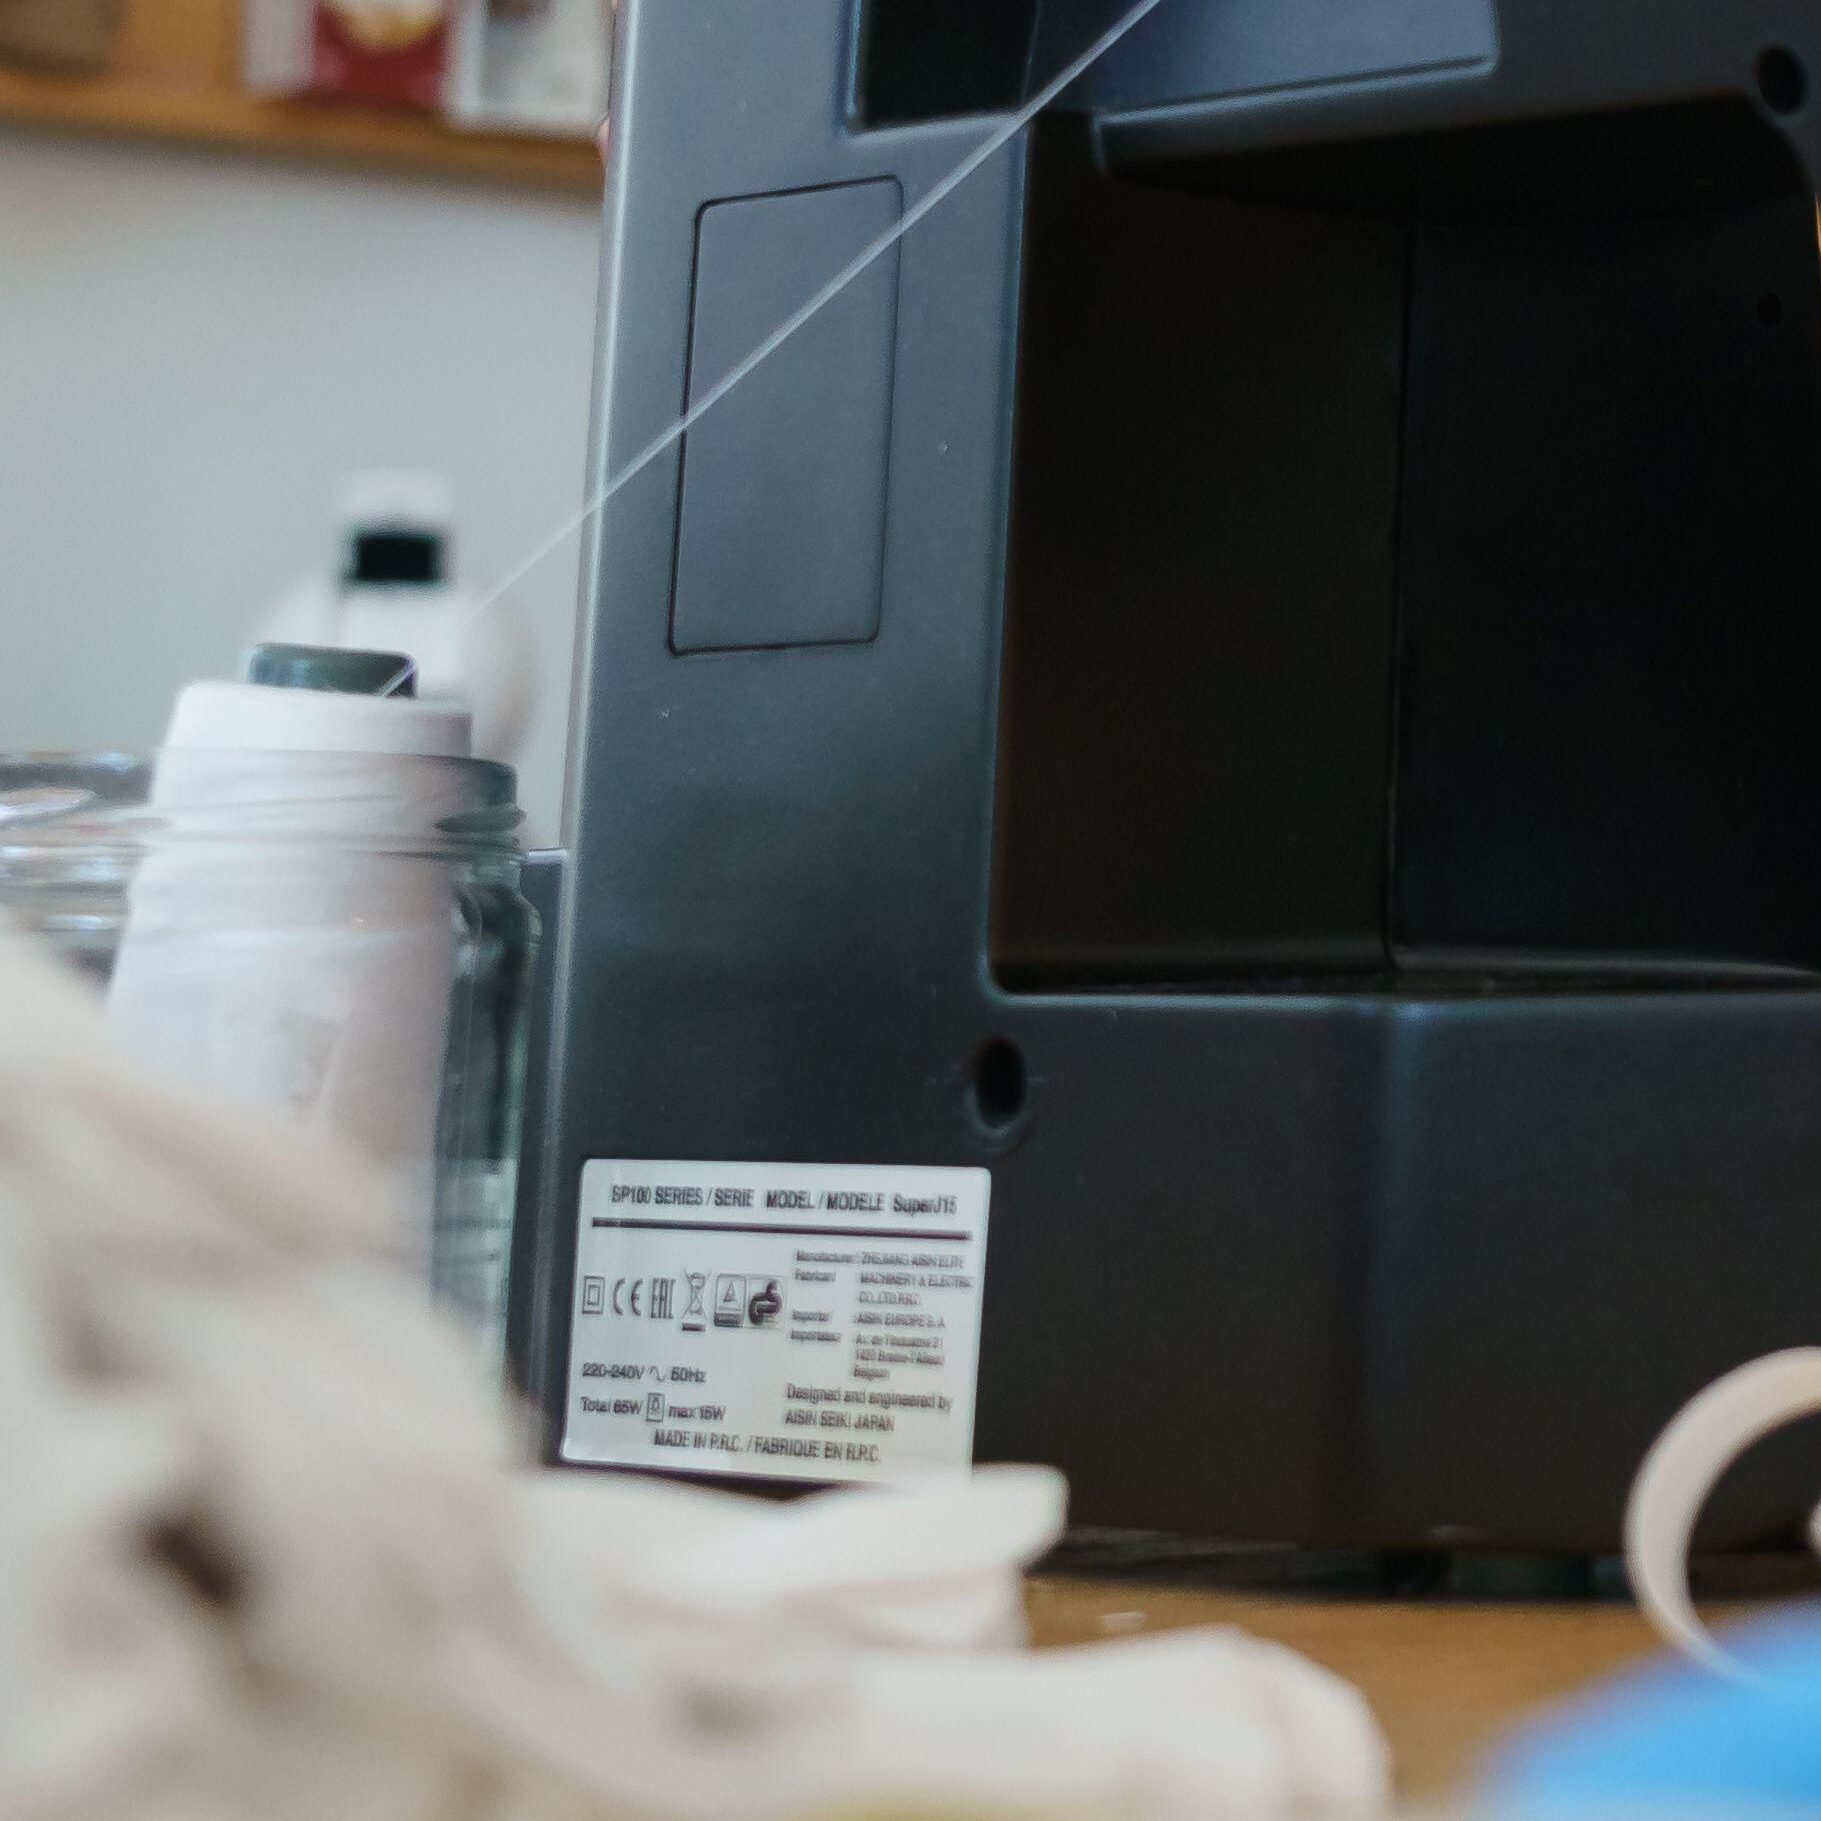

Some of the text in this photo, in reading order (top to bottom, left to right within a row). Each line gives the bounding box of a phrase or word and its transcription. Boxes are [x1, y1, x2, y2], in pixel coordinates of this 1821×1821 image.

[655, 1185, 703, 1206] SERIES
[714, 1187, 754, 1208] SERIE
[766, 1189, 815, 1209] MODEL
[827, 1191, 885, 1212] MODELE
[581, 1362, 645, 1380] 220-240V
[580, 1395, 611, 1413] Total
[667, 1404, 696, 1419] max
[786, 1382, 841, 1405] Designed
[843, 1387, 866, 1404] and
[868, 1389, 936, 1410] engineered
[785, 1408, 896, 1432] AISIN SEIKI JAPAN
[654, 1428, 690, 1447] MADE
[693, 1431, 707, 1449] IN
[755, 1435, 820, 1459] FABRIQUE
[824, 1441, 844, 1461] EN
